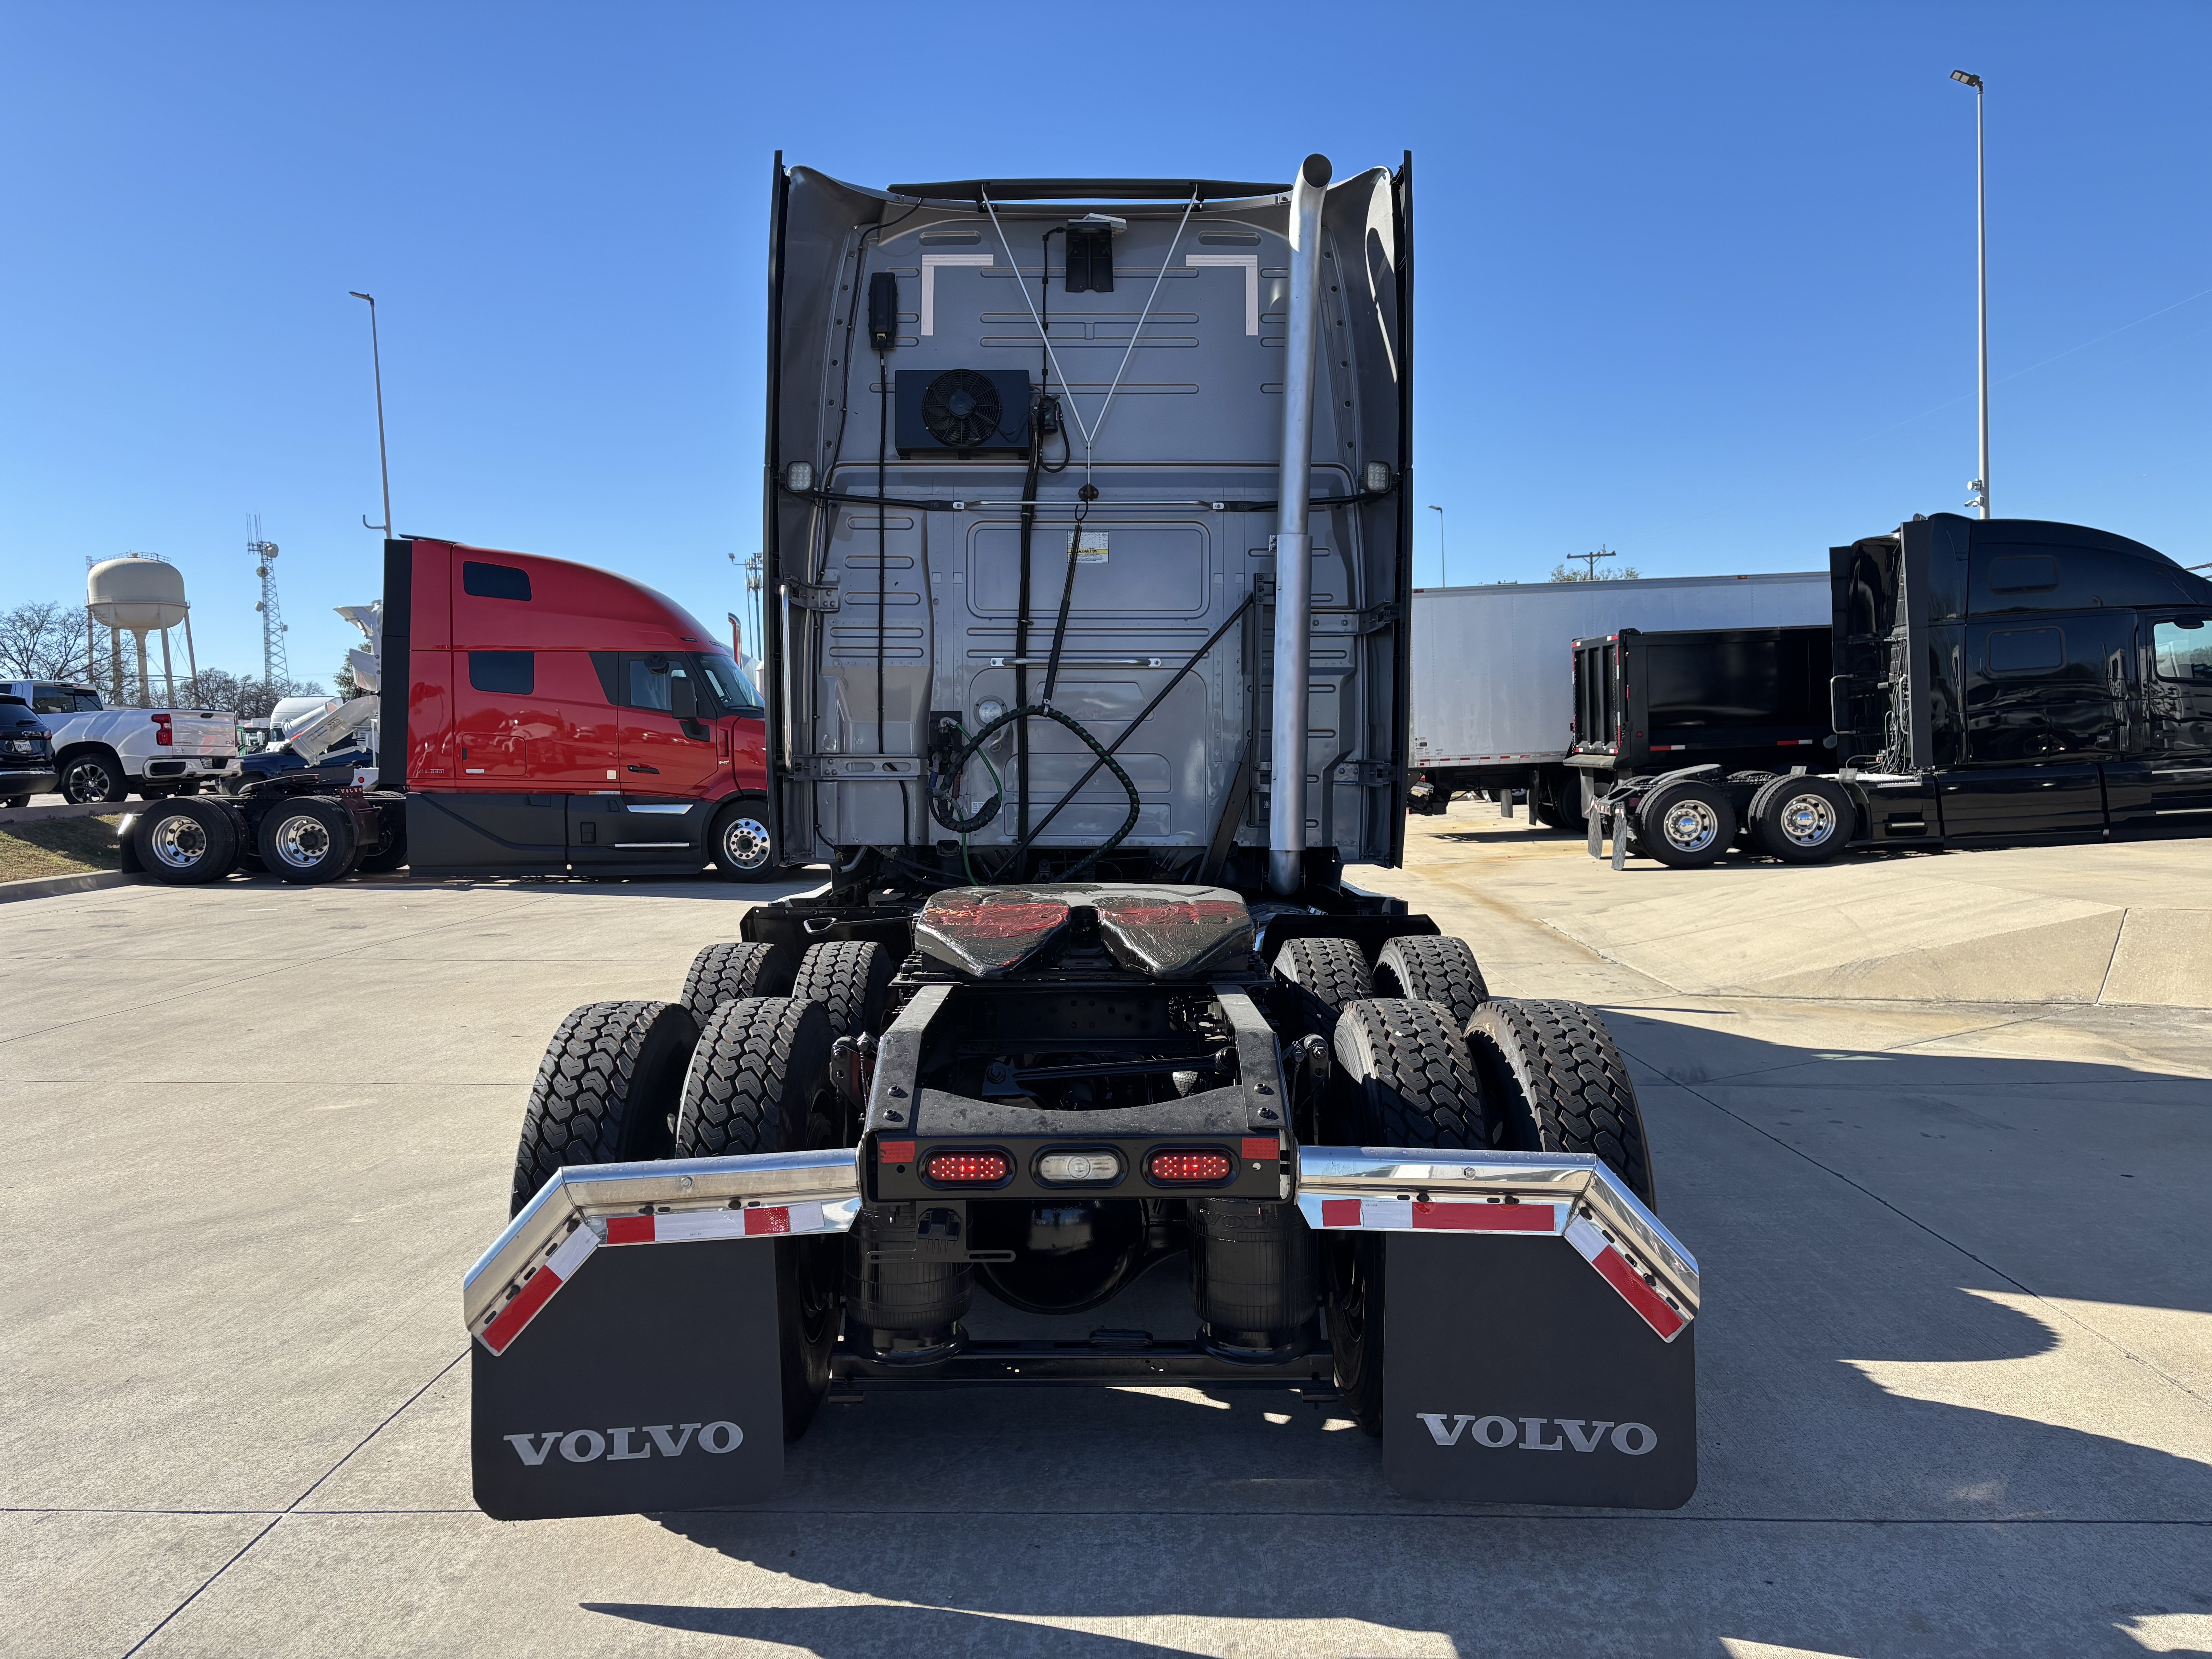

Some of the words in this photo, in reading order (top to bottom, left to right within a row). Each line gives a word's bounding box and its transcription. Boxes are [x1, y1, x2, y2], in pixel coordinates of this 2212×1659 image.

[1199, 1207, 1304, 1228] VOLO
[503, 1421, 744, 1466] VOLVO
[1416, 1413, 1657, 1455] VOLVO
